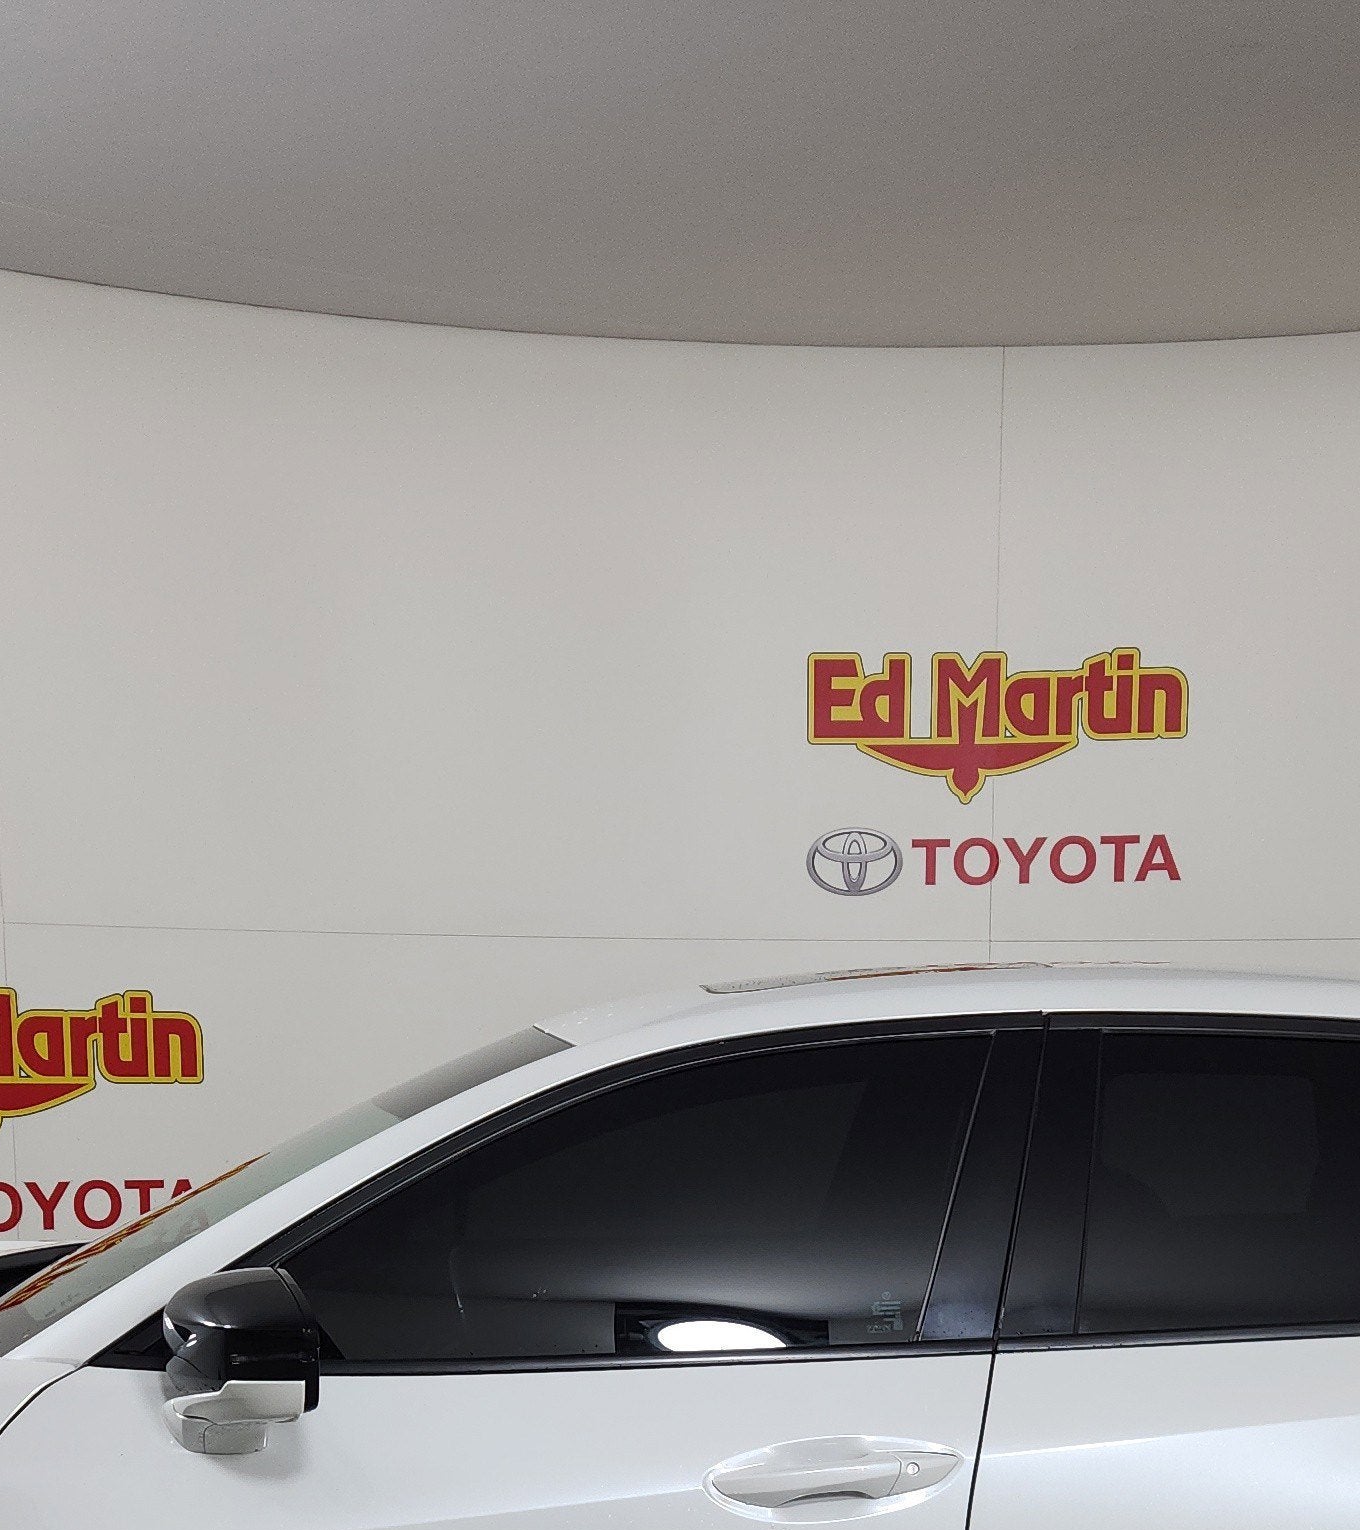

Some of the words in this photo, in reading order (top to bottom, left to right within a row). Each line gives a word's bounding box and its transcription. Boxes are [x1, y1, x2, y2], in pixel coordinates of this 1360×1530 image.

[810, 655, 909, 741] Ed
[933, 650, 1187, 741] Martin
[911, 834, 1181, 886] TOYOTA
